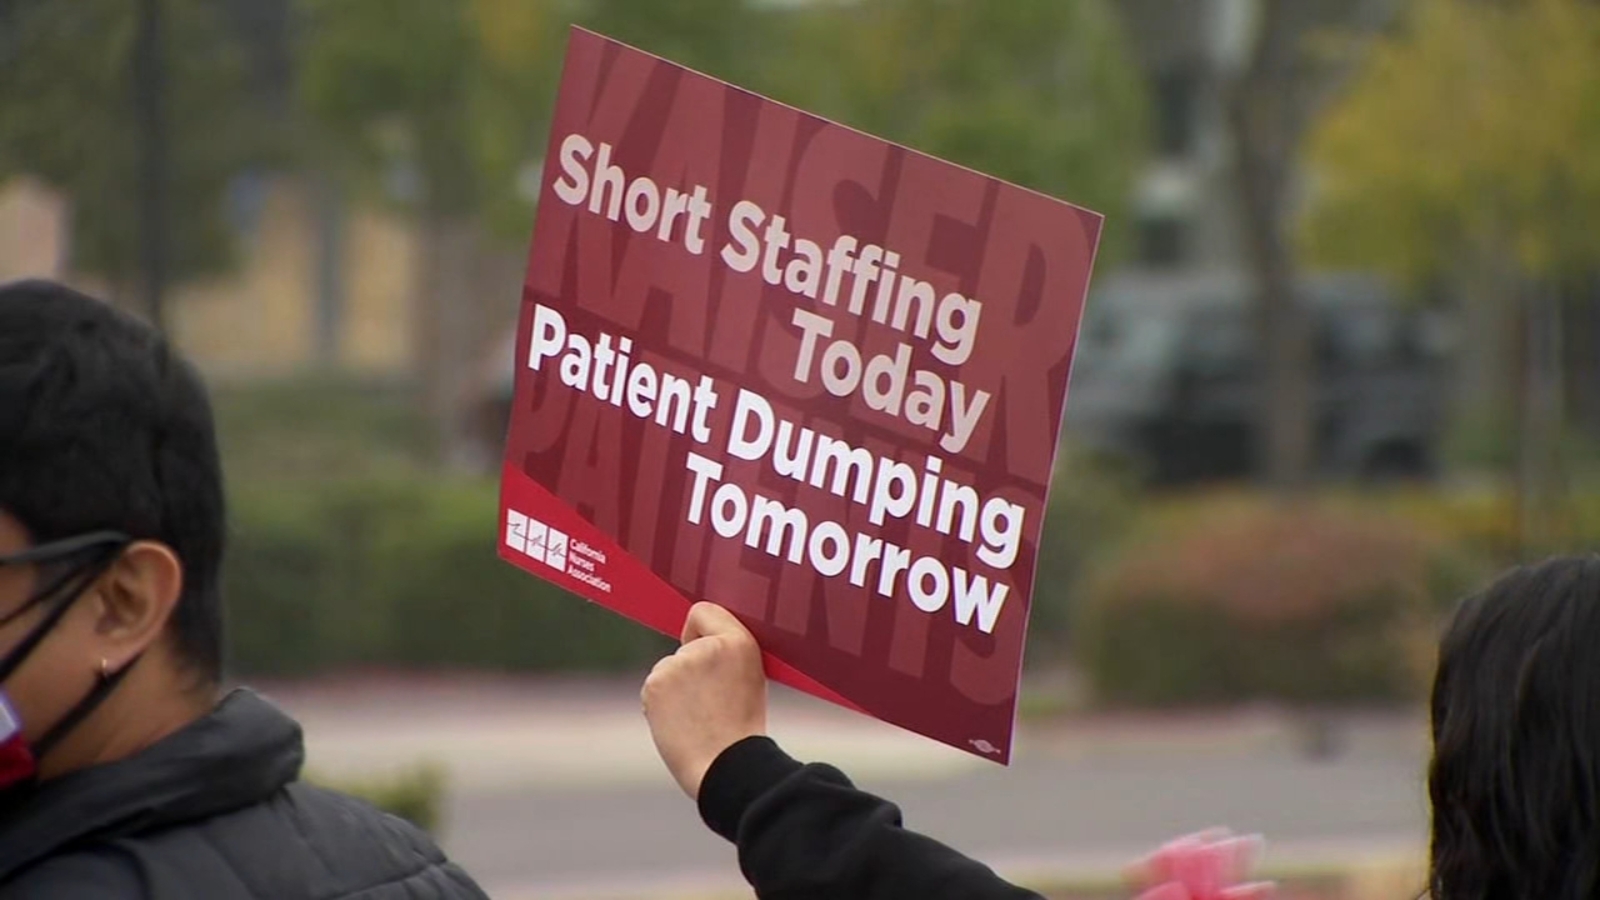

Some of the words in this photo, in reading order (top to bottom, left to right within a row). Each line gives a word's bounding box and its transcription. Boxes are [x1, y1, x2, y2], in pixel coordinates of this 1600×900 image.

[552, 133, 711, 255] Short
[720, 200, 982, 365] Staffing
[527, 303, 717, 442] Patient
[728, 389, 1025, 569] Dumping
[792, 307, 991, 453] Today
[567, 564, 612, 593] Association
[569, 550, 595, 572] Nurses
[570, 538, 606, 565] California
[686, 451, 1009, 634] Tomorrow
